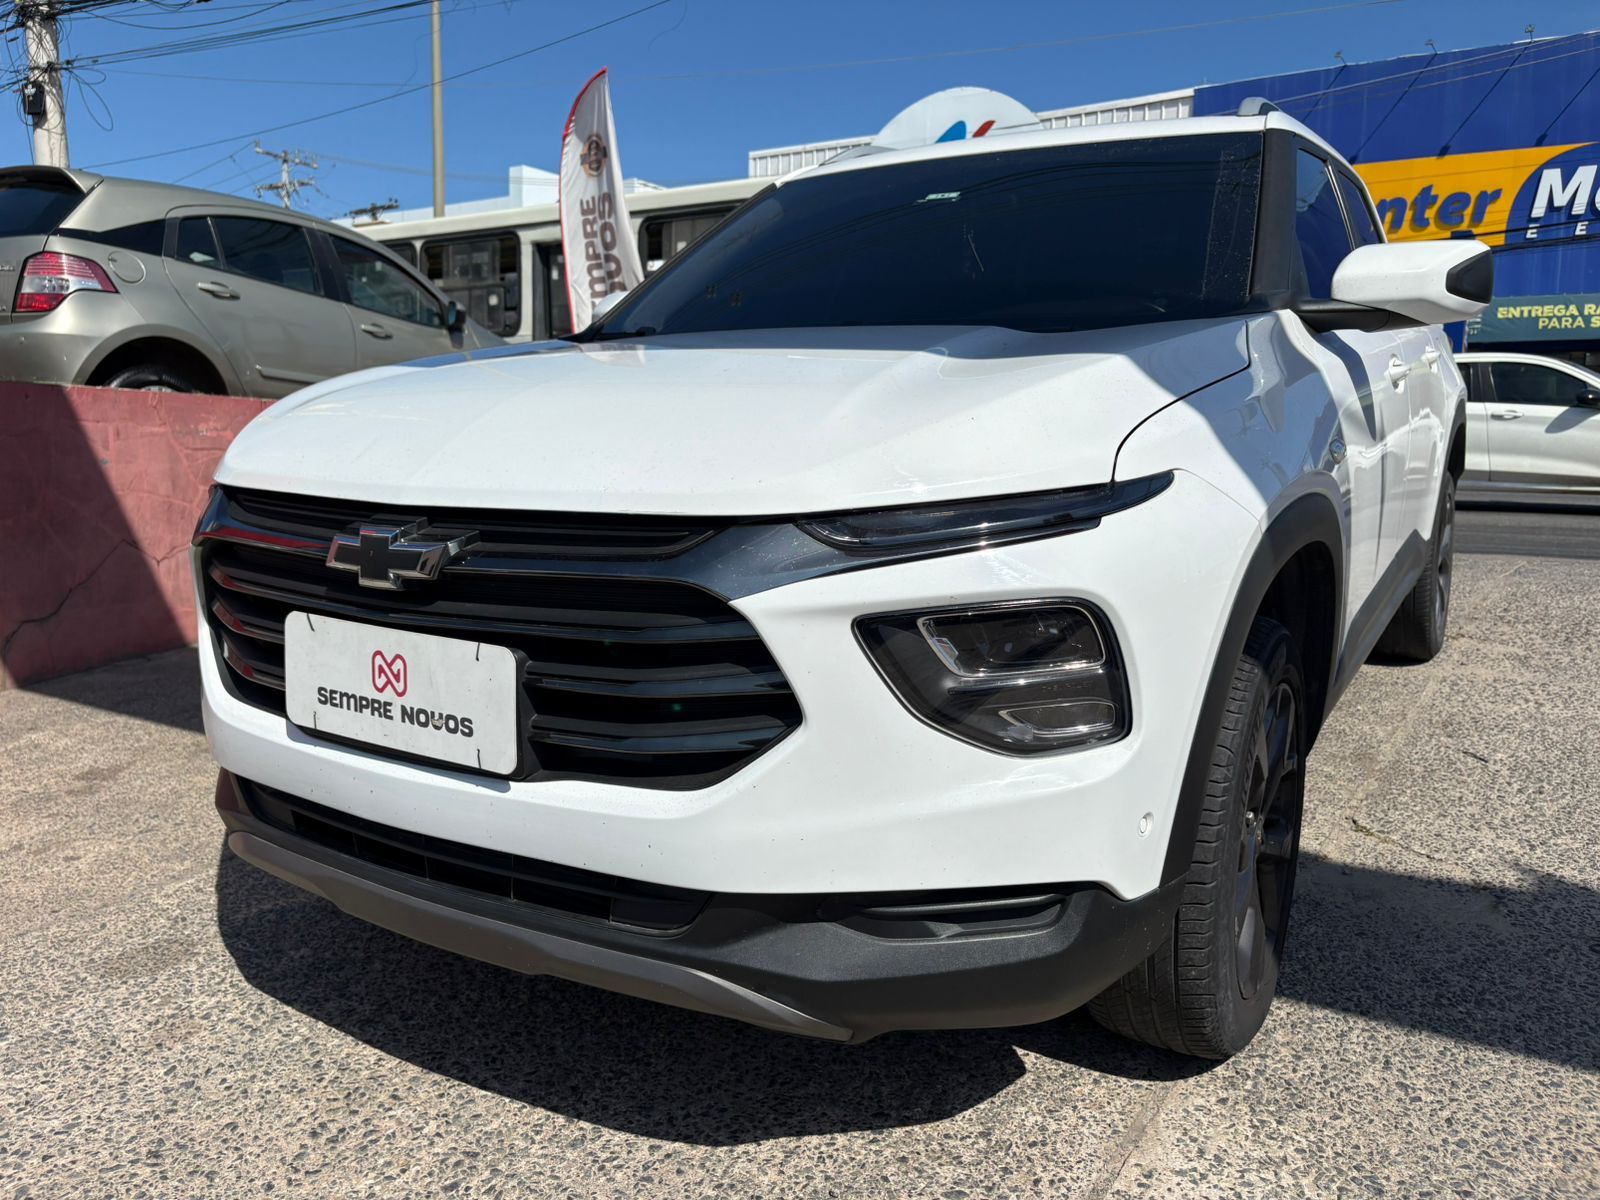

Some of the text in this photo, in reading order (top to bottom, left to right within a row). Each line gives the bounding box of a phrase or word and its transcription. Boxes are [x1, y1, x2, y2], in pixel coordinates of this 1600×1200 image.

[1377, 184, 1502, 234] nter
[1531, 165, 1600, 218] M
[580, 195, 609, 308] MPRE
[1497, 303, 1580, 319] ENTREGA
[1538, 316, 1585, 330] PARA
[317, 686, 394, 721] SEMPRE
